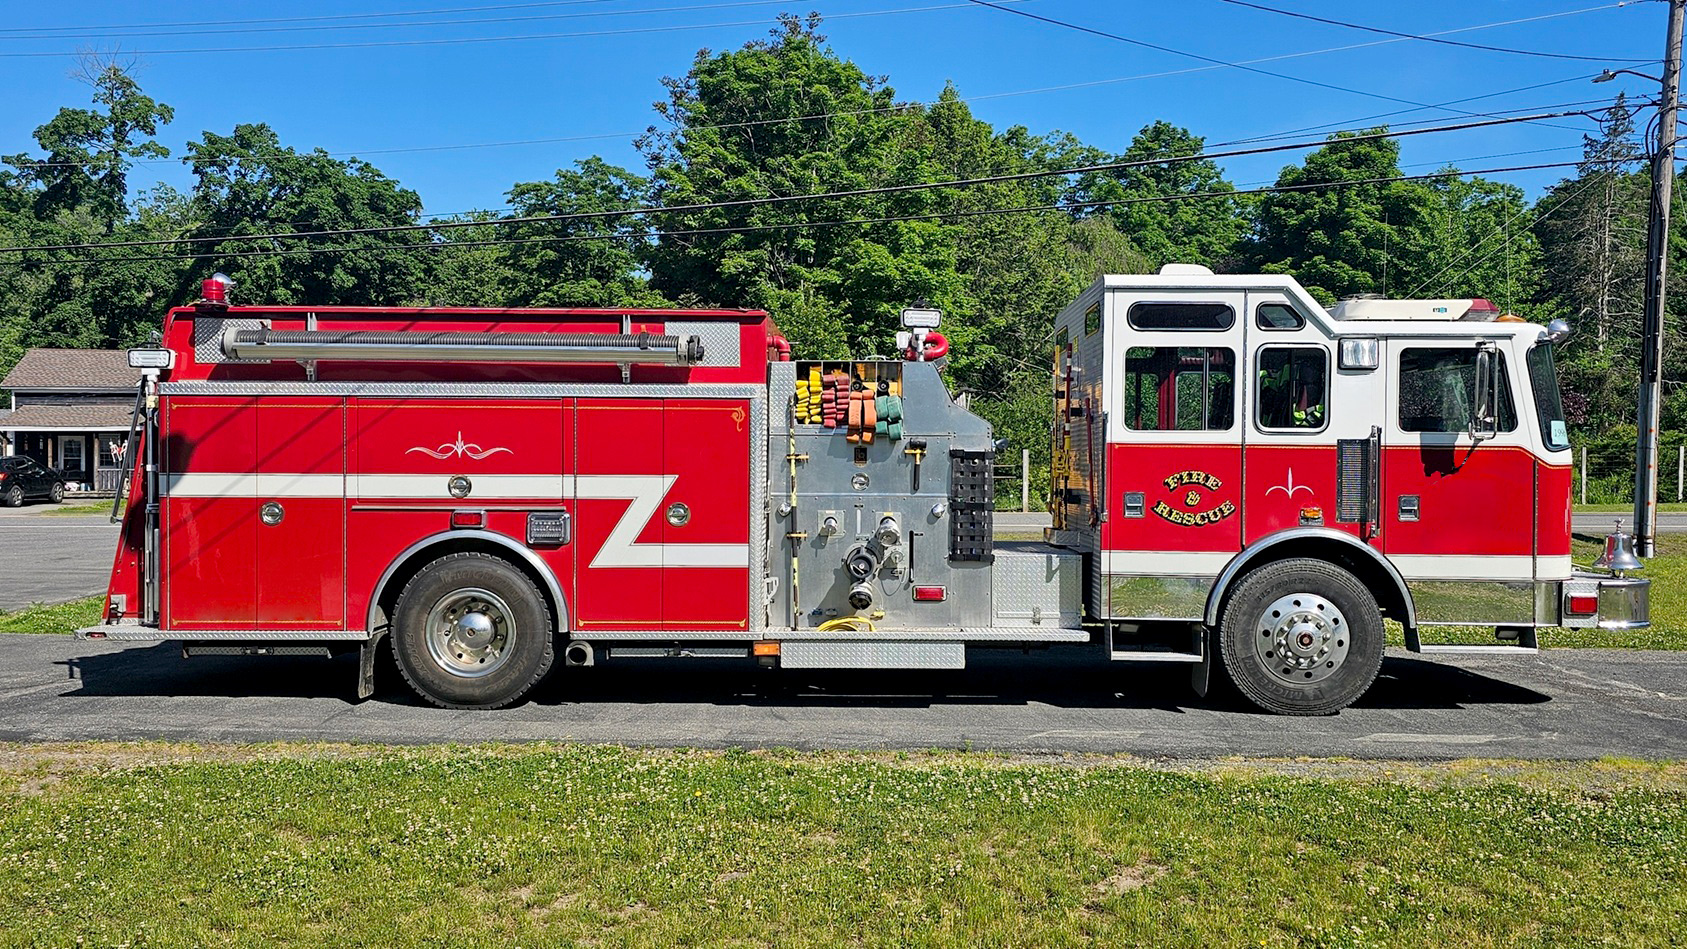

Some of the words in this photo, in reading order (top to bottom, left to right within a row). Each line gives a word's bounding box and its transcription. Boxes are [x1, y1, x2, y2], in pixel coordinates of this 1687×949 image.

[1164, 470, 1223, 491] FIRE
[1185, 490, 1201, 506] &
[1151, 500, 1236, 526] RESCUE
[1244, 656, 1305, 701] MICHELIN
